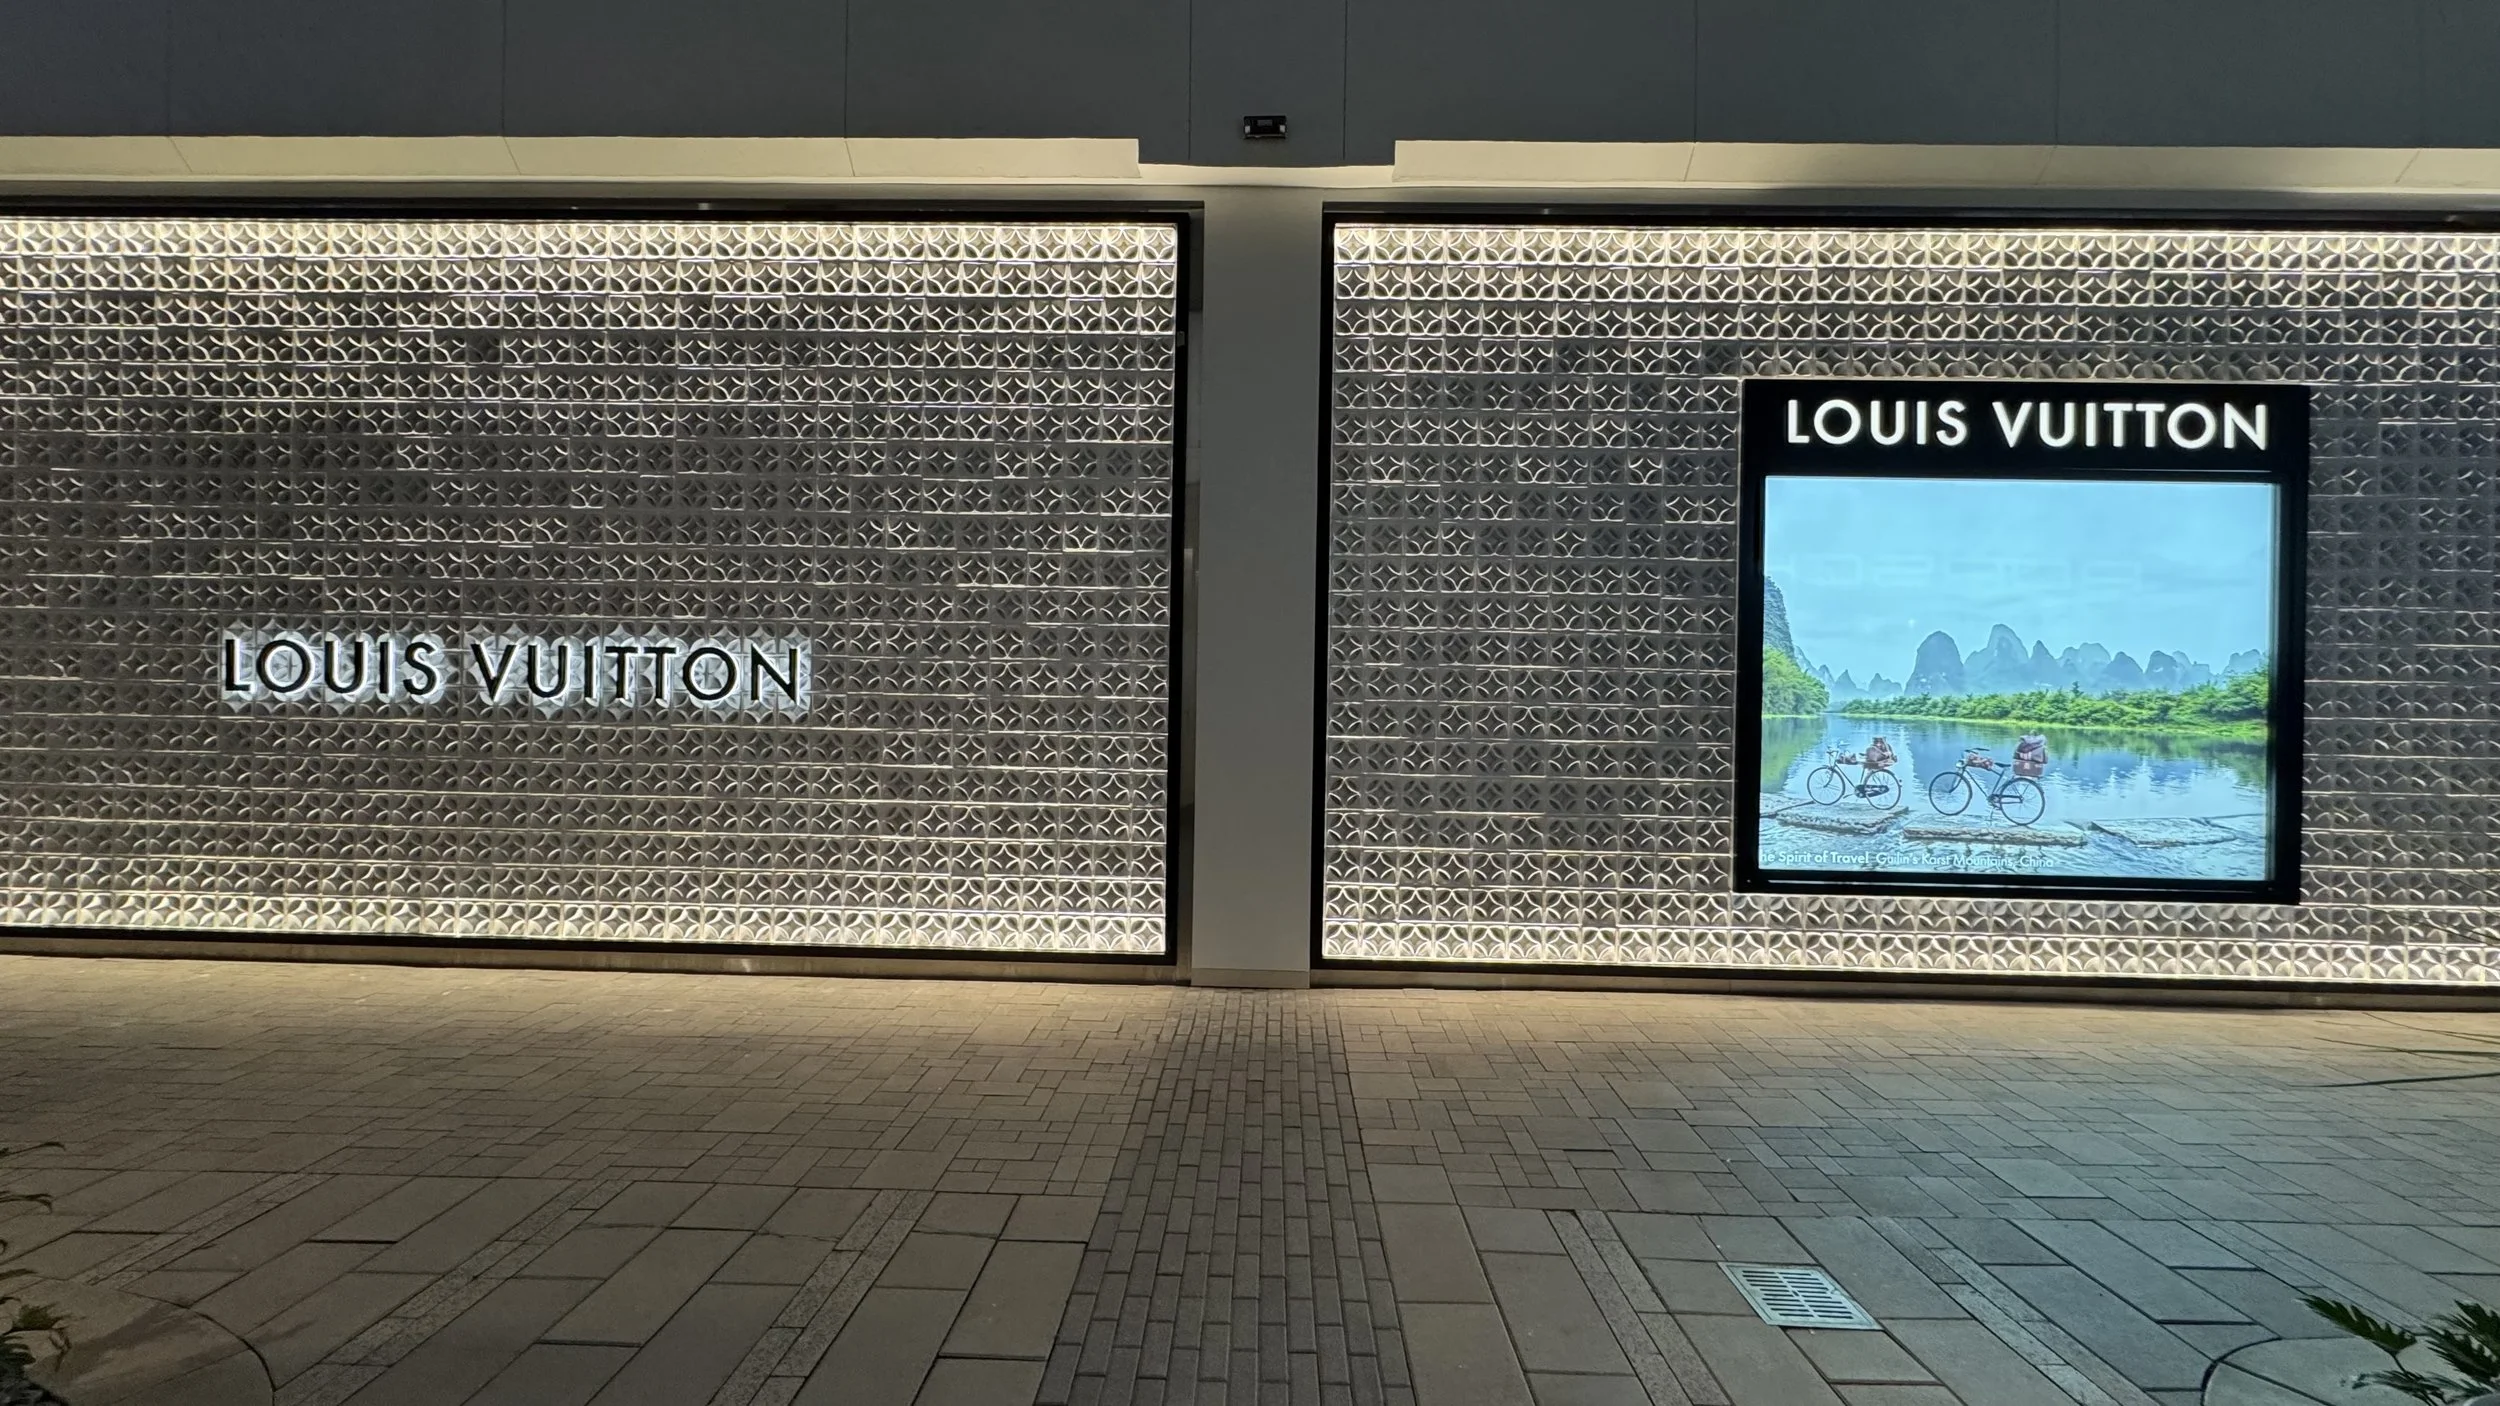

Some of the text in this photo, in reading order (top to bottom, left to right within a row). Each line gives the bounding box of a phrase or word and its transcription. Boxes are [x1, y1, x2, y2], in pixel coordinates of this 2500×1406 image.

[1787, 399, 2268, 450] LOUIS VUITTON
[223, 638, 800, 701] LOUIS VUITTON
[1759, 850, 1775, 862] he
[1778, 850, 1812, 865] Spirit
[1814, 850, 1828, 863] of
[1875, 851, 1919, 865] Guilin's
[1921, 853, 1951, 865] Karst
[2019, 855, 2054, 867] China
